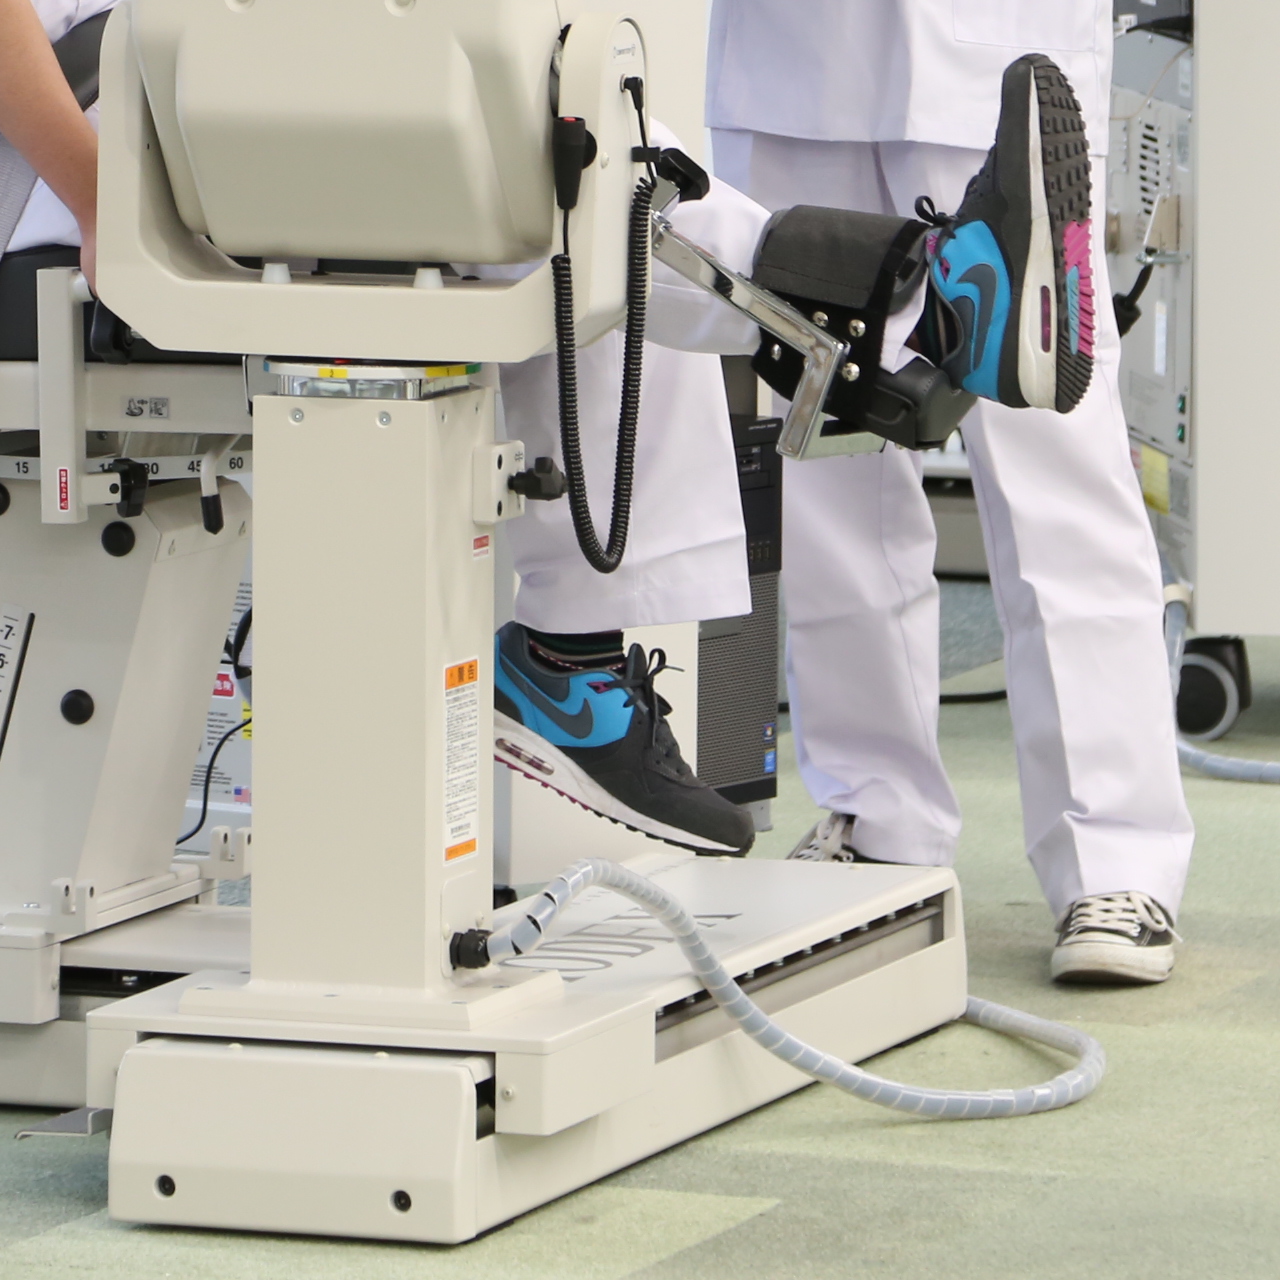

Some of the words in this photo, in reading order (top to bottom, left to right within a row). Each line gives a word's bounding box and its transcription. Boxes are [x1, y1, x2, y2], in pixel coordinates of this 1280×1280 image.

[15, 461, 29, 474] 15
[229, 457, 244, 470] 60
[4, 624, 14, 640] 7
[498, 908, 743, 982] ODEX
